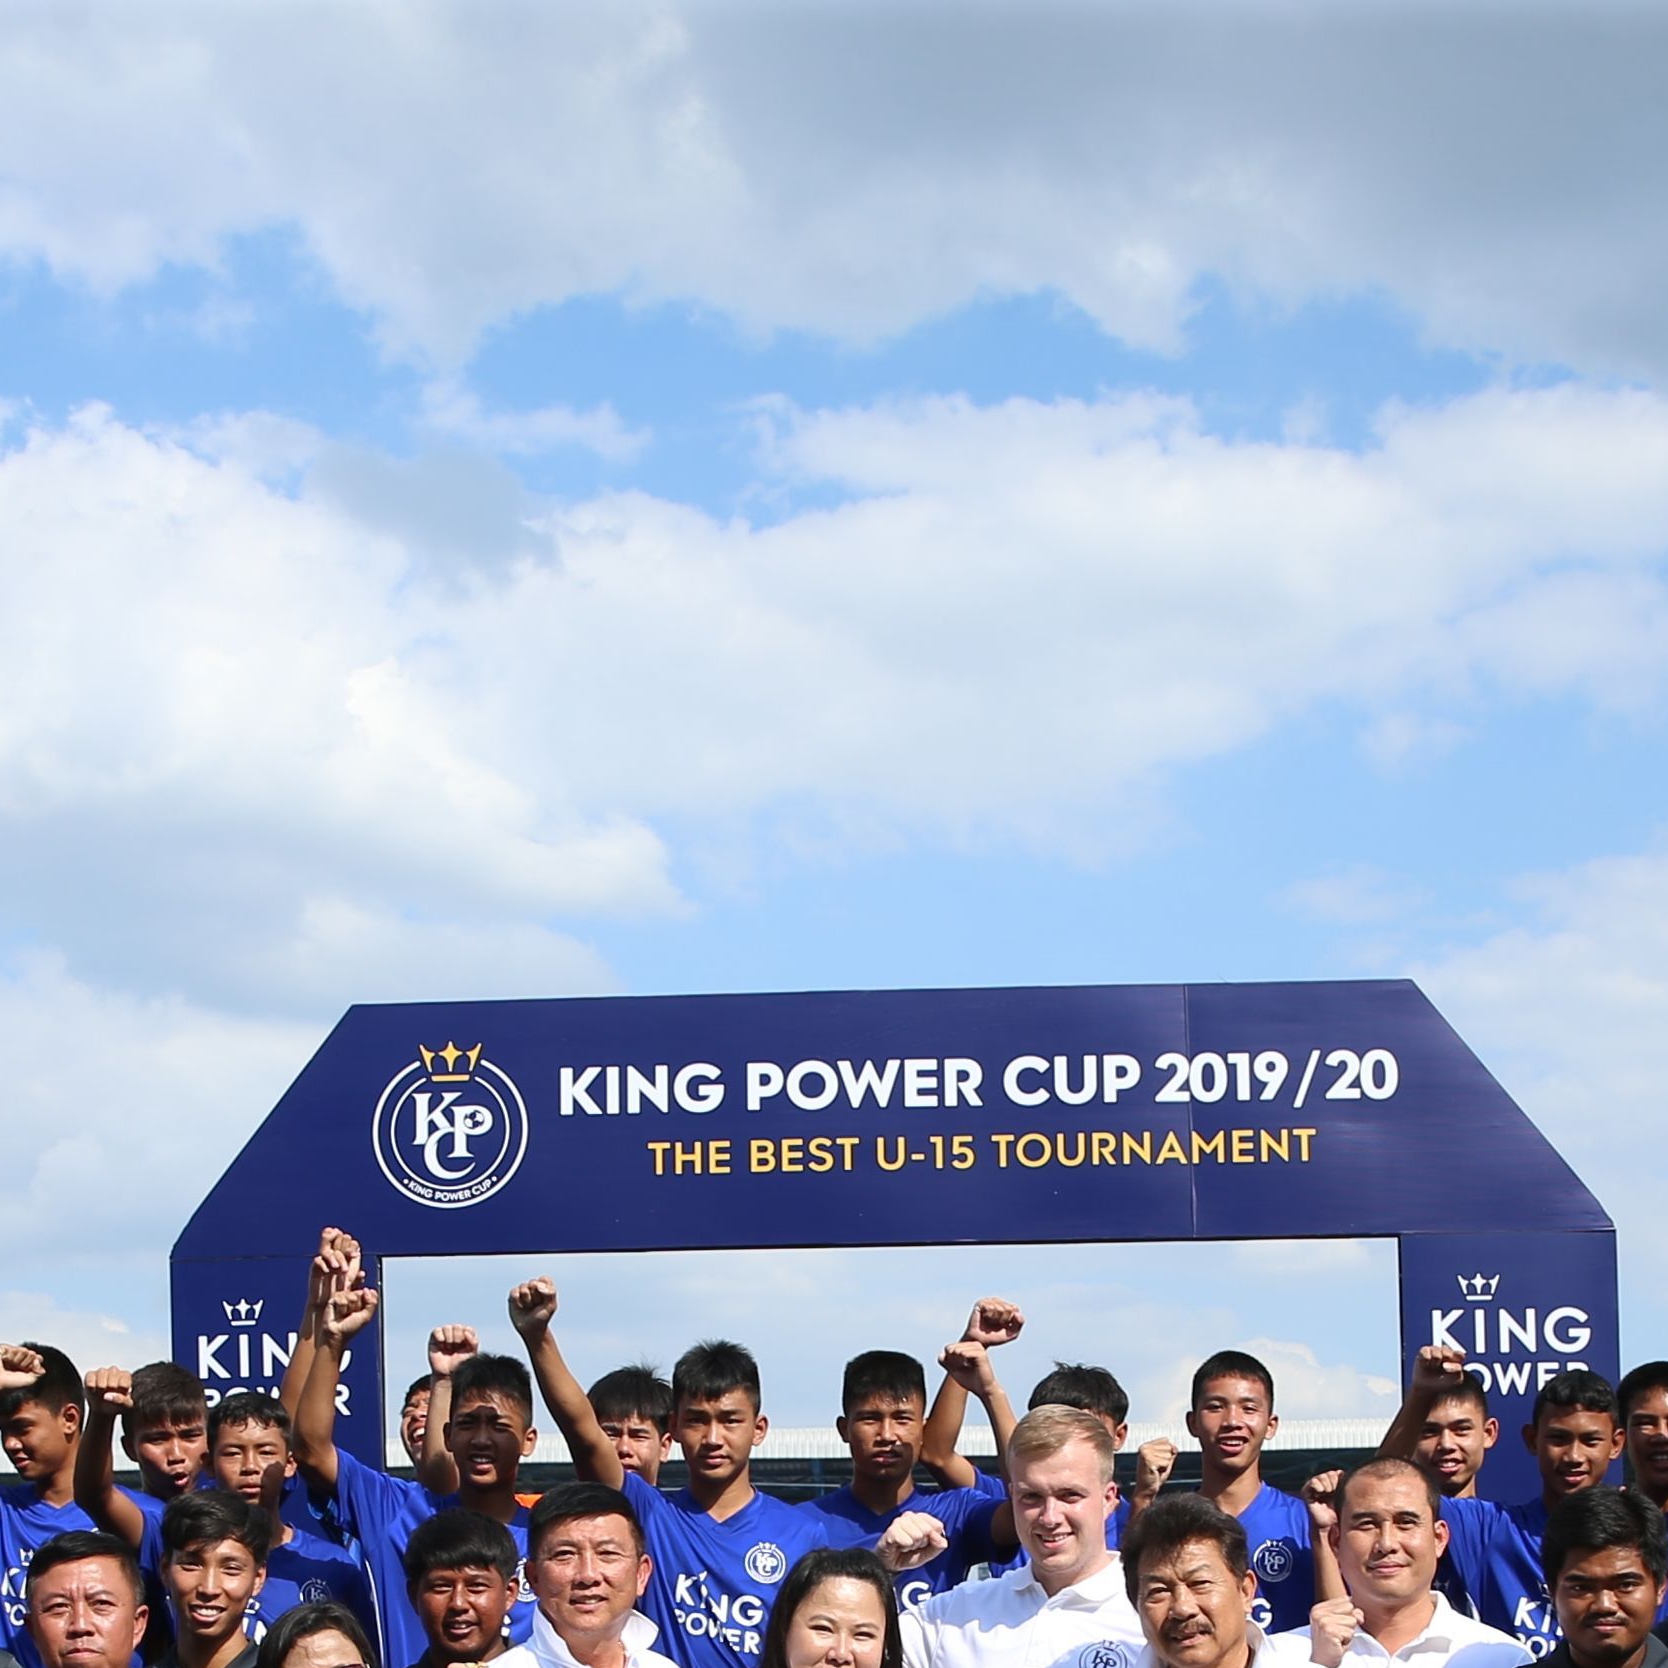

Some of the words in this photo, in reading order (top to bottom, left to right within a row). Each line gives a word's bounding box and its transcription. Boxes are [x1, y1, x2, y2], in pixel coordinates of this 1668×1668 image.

[561, 1063, 724, 1115] KING
[747, 1057, 982, 1111] POWER
[1004, 1053, 1133, 1107] CUP
[1153, 1048, 1399, 1107] 2019/20
[648, 1140, 730, 1175] THE
[751, 1137, 860, 1173] BEST
[877, 1135, 975, 1170] U-15
[992, 1128, 1317, 1168] TOURNAMENT
[408, 1180, 433, 1198] KING
[435, 1189, 471, 1201] POWER
[471, 1179, 492, 1196] CUP
[1431, 1307, 1591, 1354] KING
[198, 1332, 352, 1380] KIN
[675, 1570, 763, 1627] KING
